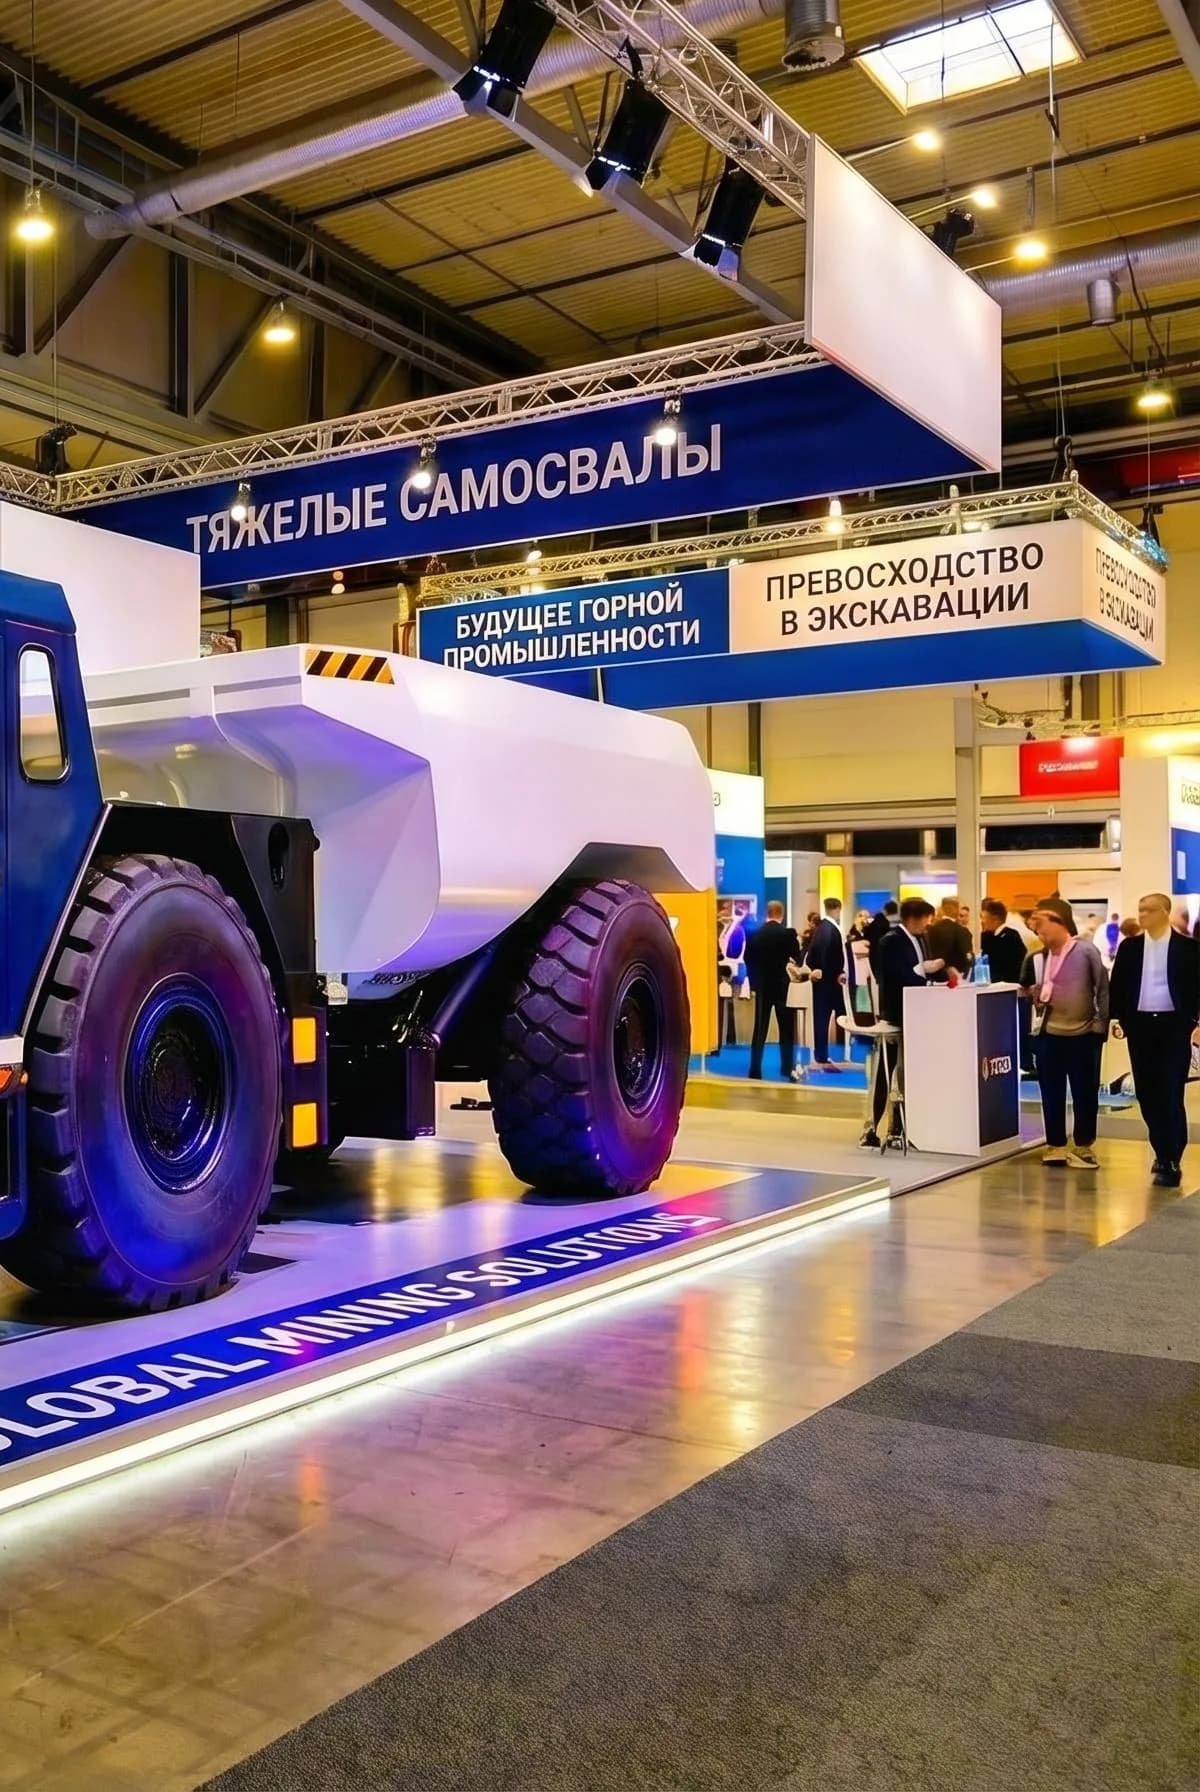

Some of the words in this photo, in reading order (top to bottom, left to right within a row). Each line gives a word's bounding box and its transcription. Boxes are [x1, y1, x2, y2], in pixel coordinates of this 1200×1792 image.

[186, 483, 388, 553] ТЯЖЕЛЫЕ
[400, 424, 721, 522] САМОСВАЛЫ
[766, 542, 1044, 602] ПРЕВОСХОДСТВО
[456, 601, 572, 640] БУДУЩЕЕ
[579, 581, 684, 624] ГОРНОЙ
[781, 609, 798, 636] В
[808, 582, 1029, 632] ЭКСКАВАЦИИ
[443, 618, 701, 671] ПРОМЫШЛЕННОСТИ
[226, 1281, 477, 1356] MINING
